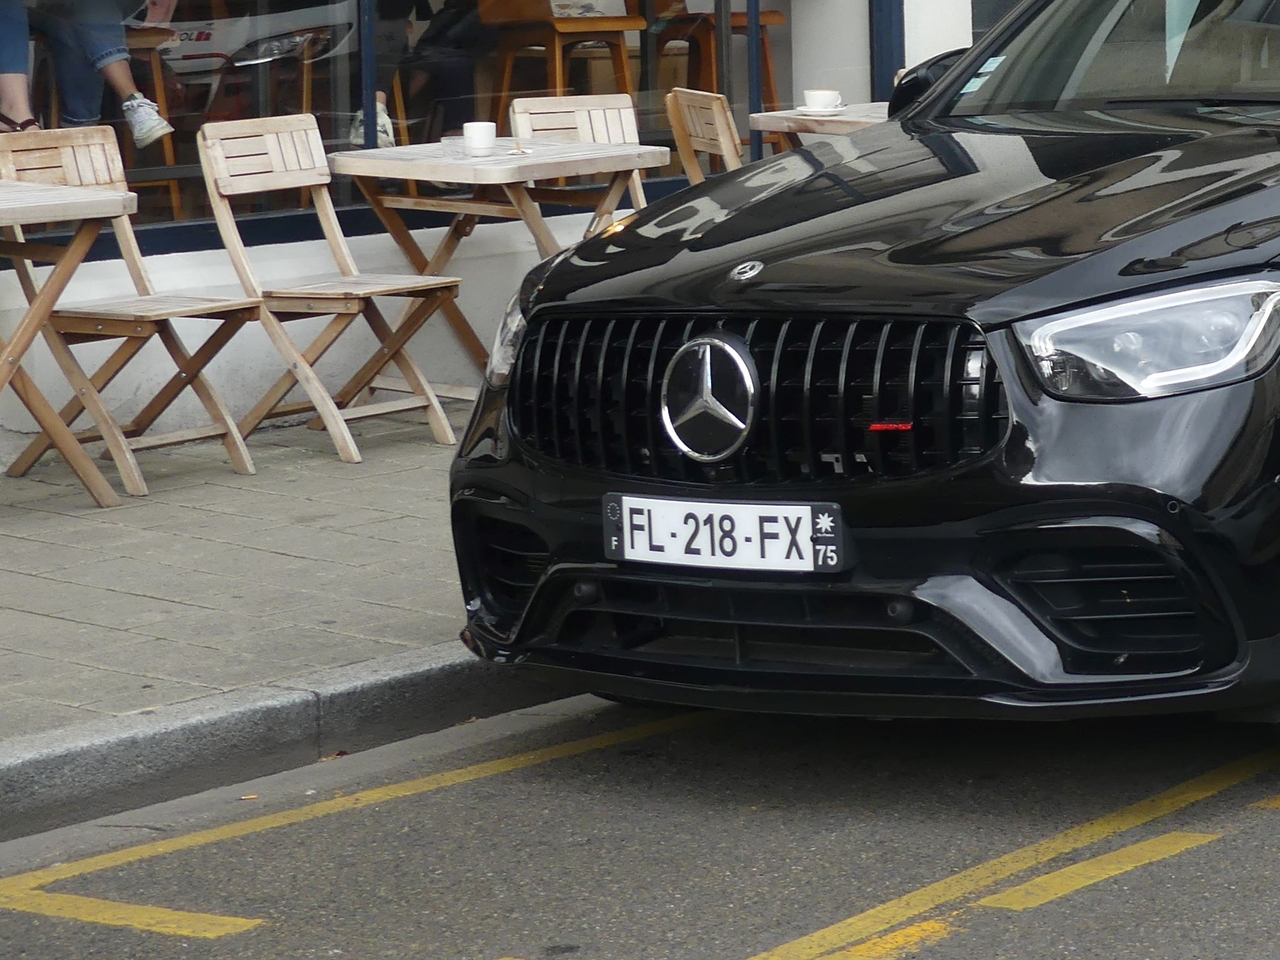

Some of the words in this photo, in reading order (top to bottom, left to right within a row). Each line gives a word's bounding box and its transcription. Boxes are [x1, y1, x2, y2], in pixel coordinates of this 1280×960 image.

[611, 536, 618, 550] F
[628, 507, 805, 560] FL-218-FX
[814, 545, 838, 566] 75
